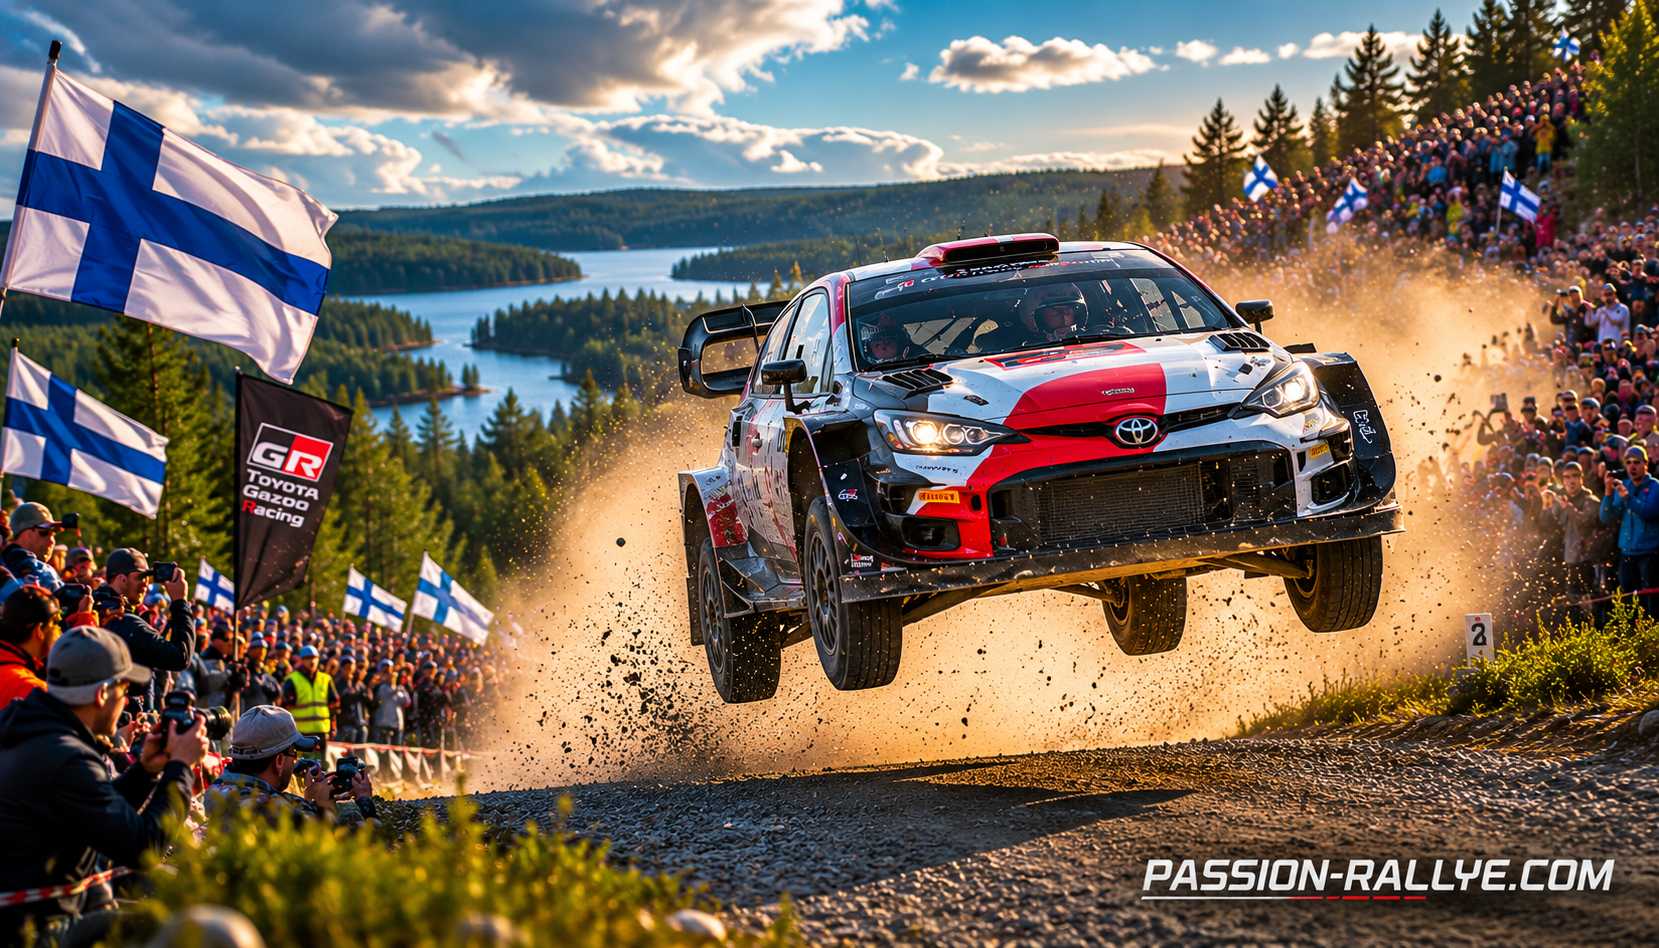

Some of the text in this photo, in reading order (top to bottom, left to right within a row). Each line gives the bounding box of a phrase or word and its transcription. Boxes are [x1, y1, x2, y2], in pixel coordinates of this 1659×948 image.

[252, 441, 323, 479] GR
[242, 484, 310, 512] Gazoo
[246, 468, 319, 501] TOYOTA
[241, 499, 305, 528] Racing
[1471, 622, 1488, 646] 2
